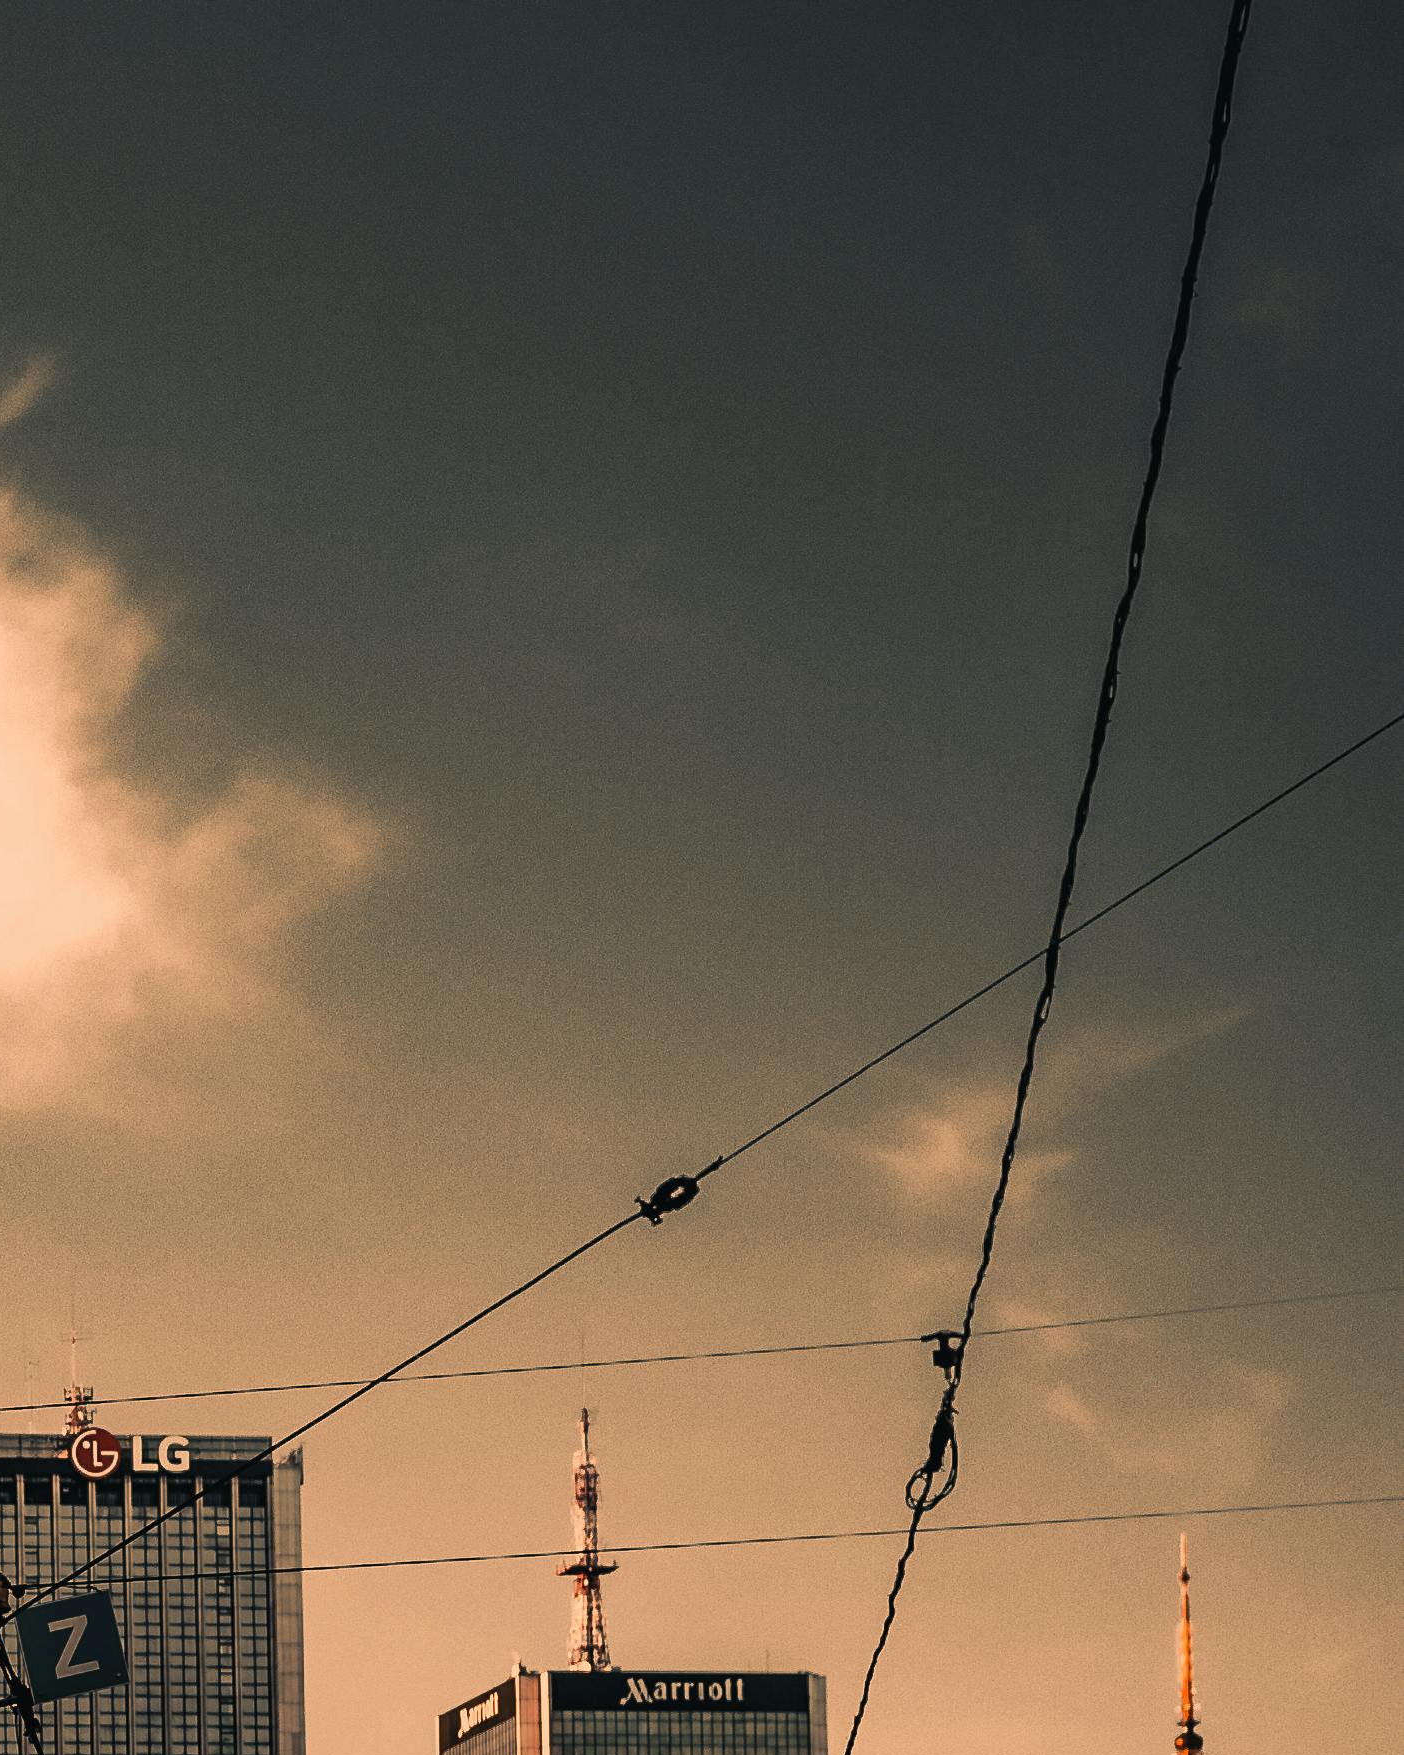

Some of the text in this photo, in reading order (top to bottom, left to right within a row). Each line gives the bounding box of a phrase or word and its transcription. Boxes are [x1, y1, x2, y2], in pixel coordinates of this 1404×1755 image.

[132, 1435, 191, 1472] LG
[47, 1614, 100, 1680] Z
[620, 1677, 745, 1705] Marriott
